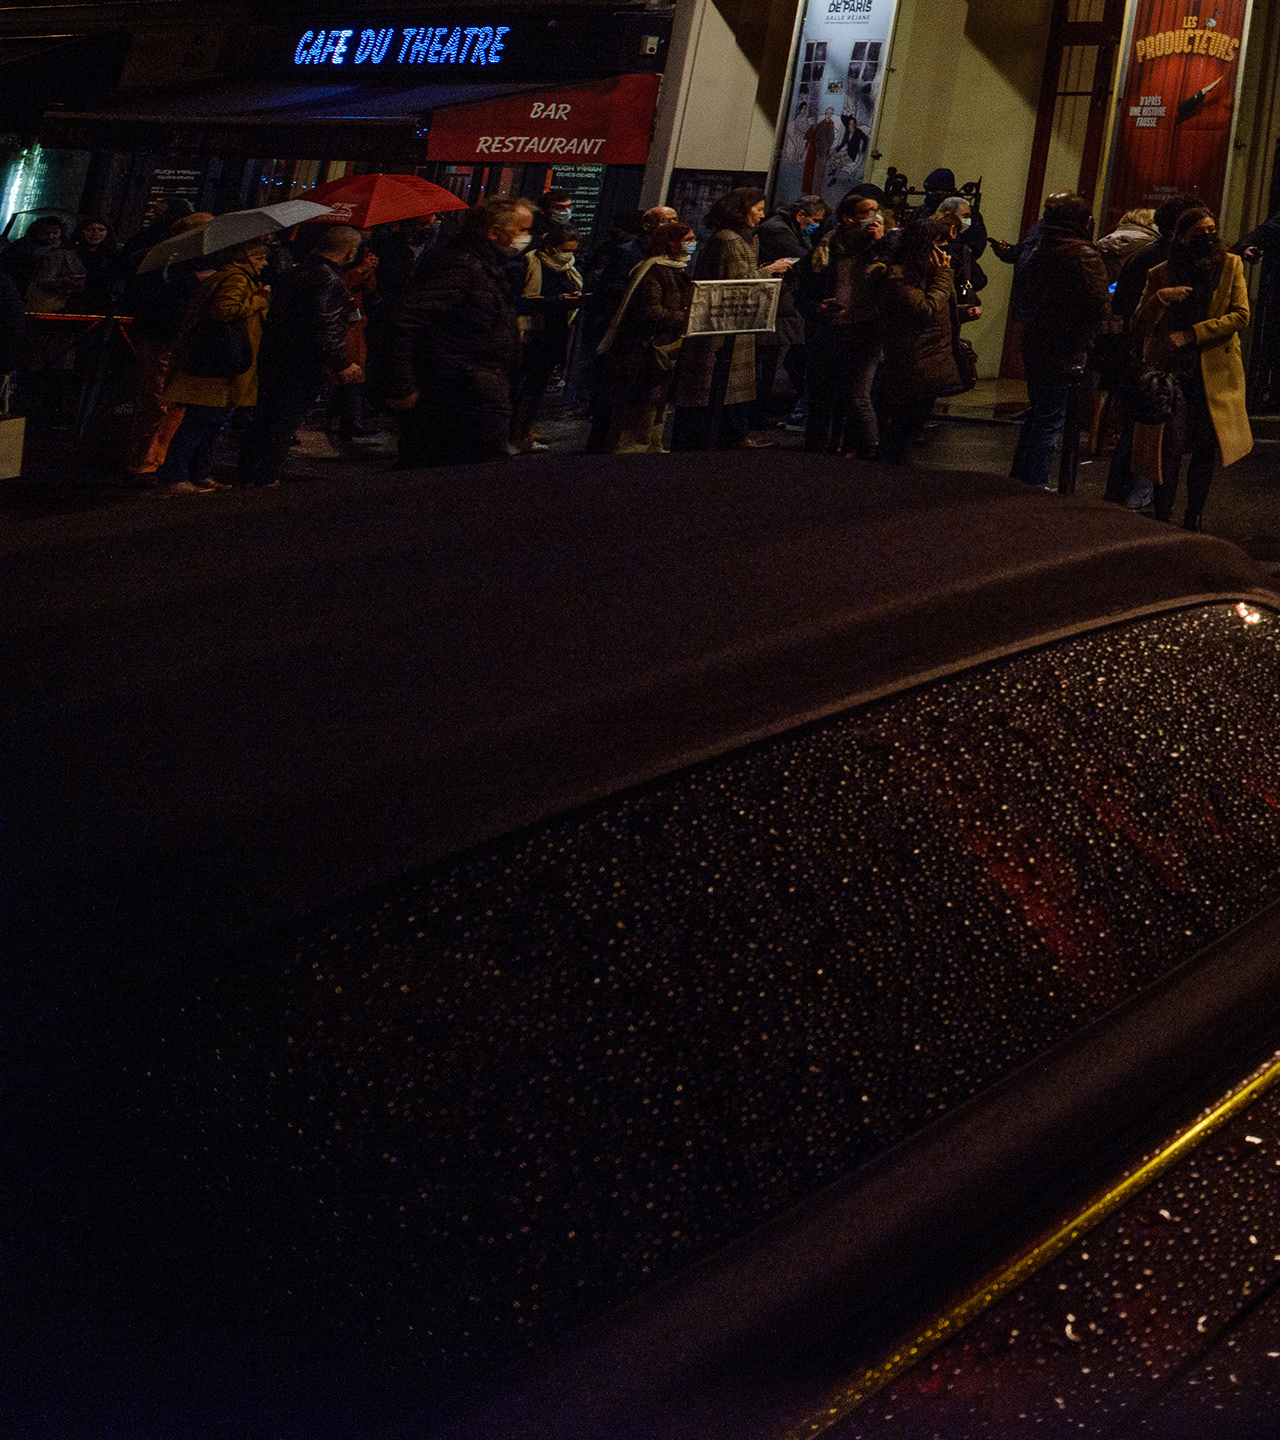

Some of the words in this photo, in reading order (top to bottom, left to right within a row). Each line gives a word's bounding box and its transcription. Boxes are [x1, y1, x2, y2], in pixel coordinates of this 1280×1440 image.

[843, 2, 872, 13] PARIS
[1183, 16, 1198, 28] LES
[354, 28, 394, 64] DU
[397, 26, 510, 65] THEATRE
[1136, 28, 1241, 63] PRODUCTEURS
[530, 102, 571, 121] BAR
[475, 136, 606, 155] RESTAURANT
